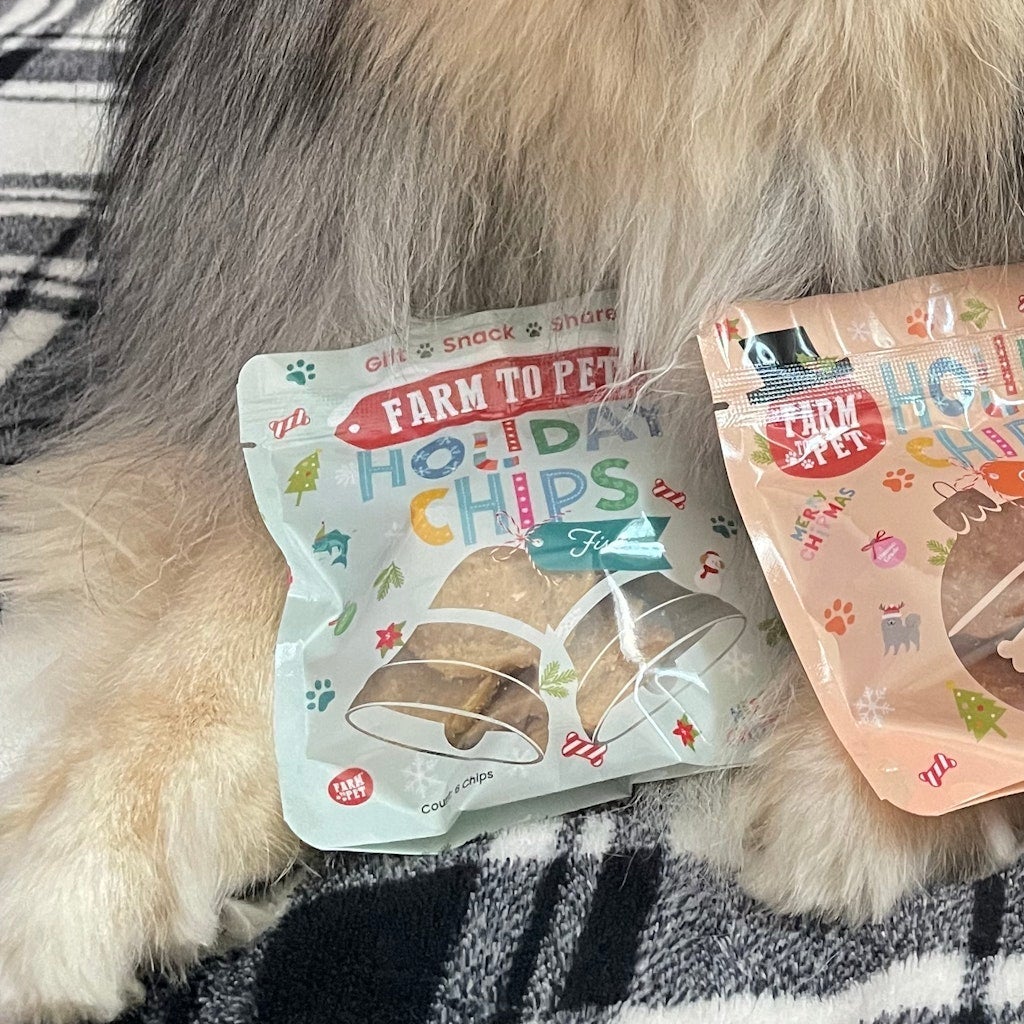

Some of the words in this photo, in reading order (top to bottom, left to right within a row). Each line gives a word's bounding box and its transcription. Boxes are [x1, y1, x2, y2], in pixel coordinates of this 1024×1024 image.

[365, 347, 408, 373] Gift
[443, 325, 515, 354] Snack
[551, 306, 617, 333] Share
[382, 374, 489, 435] FARM
[496, 364, 543, 404] TO
[553, 354, 622, 397] PET
[779, 393, 862, 438] FARM
[356, 402, 664, 504] HOLIDAY
[811, 428, 868, 466] PET
[410, 457, 639, 548] CHIPS
[790, 489, 827, 542] MERRY
[332, 772, 365, 793] FARM
[346, 786, 366, 802] PET
[454, 784, 461, 794] 6
[462, 770, 494, 789] Chips
